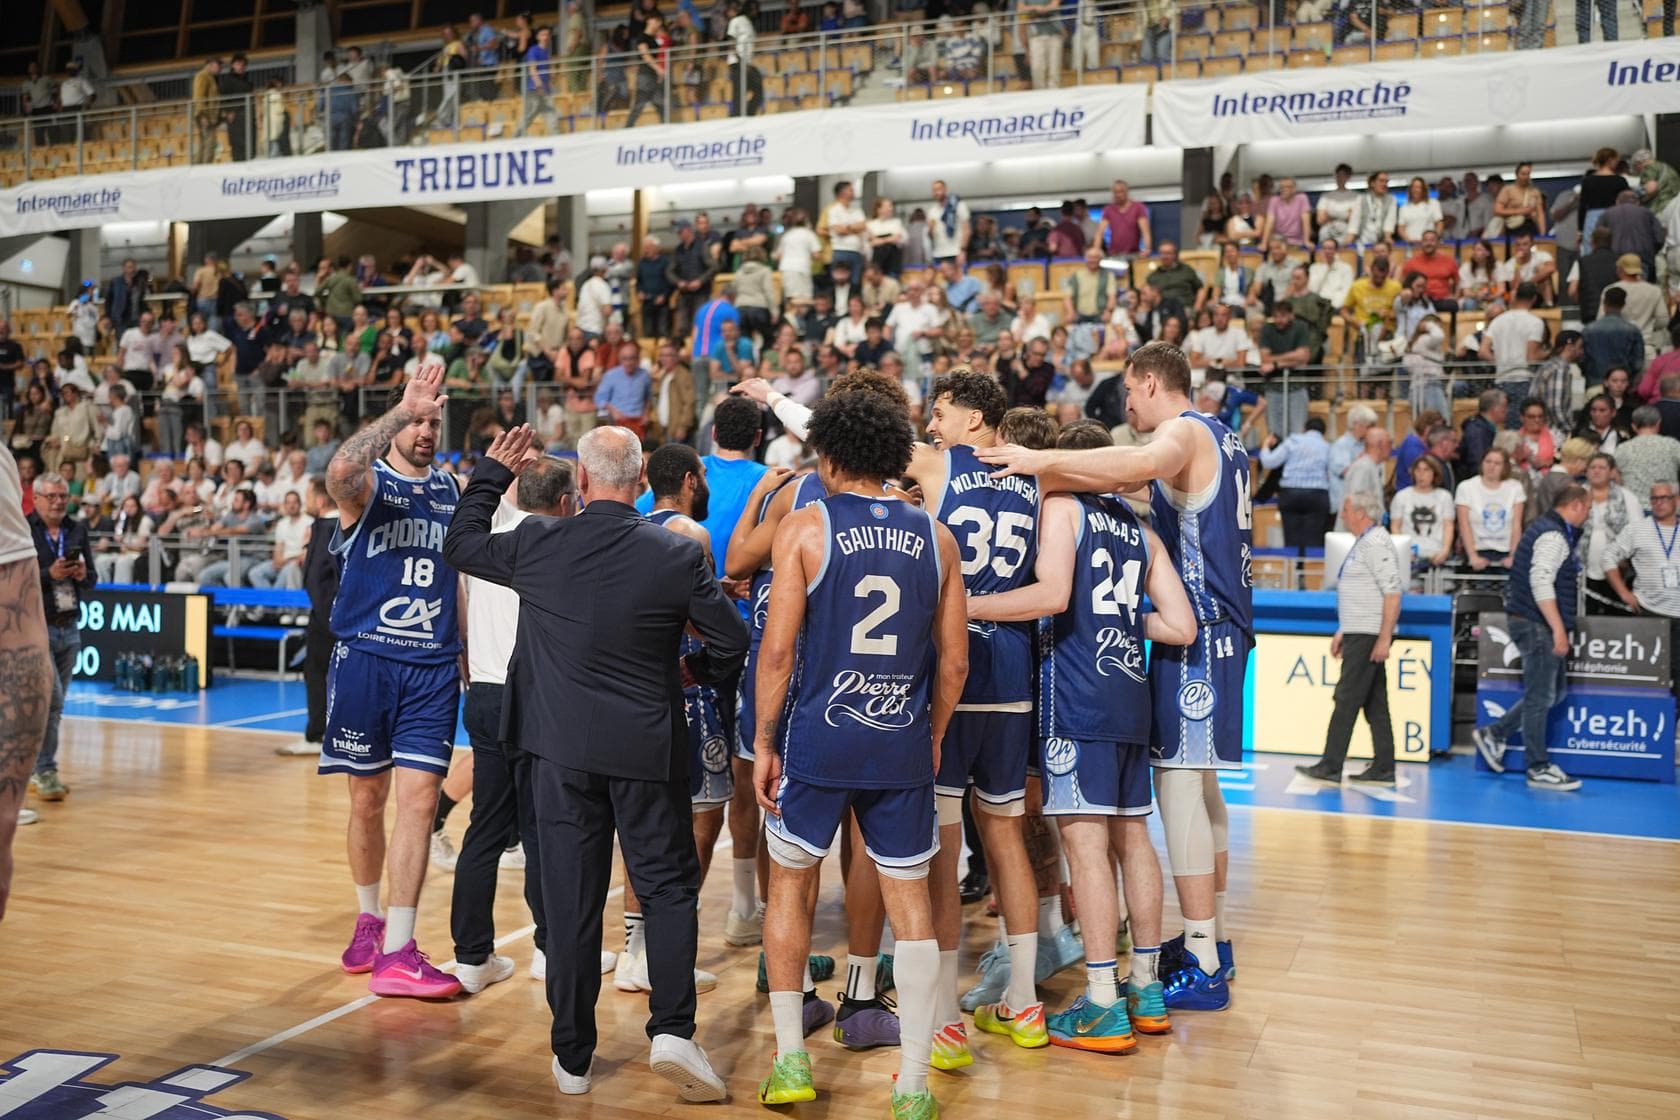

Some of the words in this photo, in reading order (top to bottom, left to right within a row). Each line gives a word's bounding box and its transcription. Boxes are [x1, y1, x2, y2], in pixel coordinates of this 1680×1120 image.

[1607, 58, 1680, 86] Inte
[395, 148, 554, 193] TRIBUNE
[835, 525, 925, 560] GAUTHIER
[947, 505, 1034, 578] 35
[401, 556, 435, 588] 18
[1091, 548, 1142, 626] 24
[110, 602, 162, 633] MAI
[850, 574, 901, 656] 2
[357, 632, 386, 643] LOIRE
[1214, 636, 1234, 658] 14
[1568, 661, 1628, 674] Téléphonie
[828, 670, 911, 705] Pierre
[865, 693, 912, 717] Clot
[1566, 736, 1648, 753] Cybersécurité
